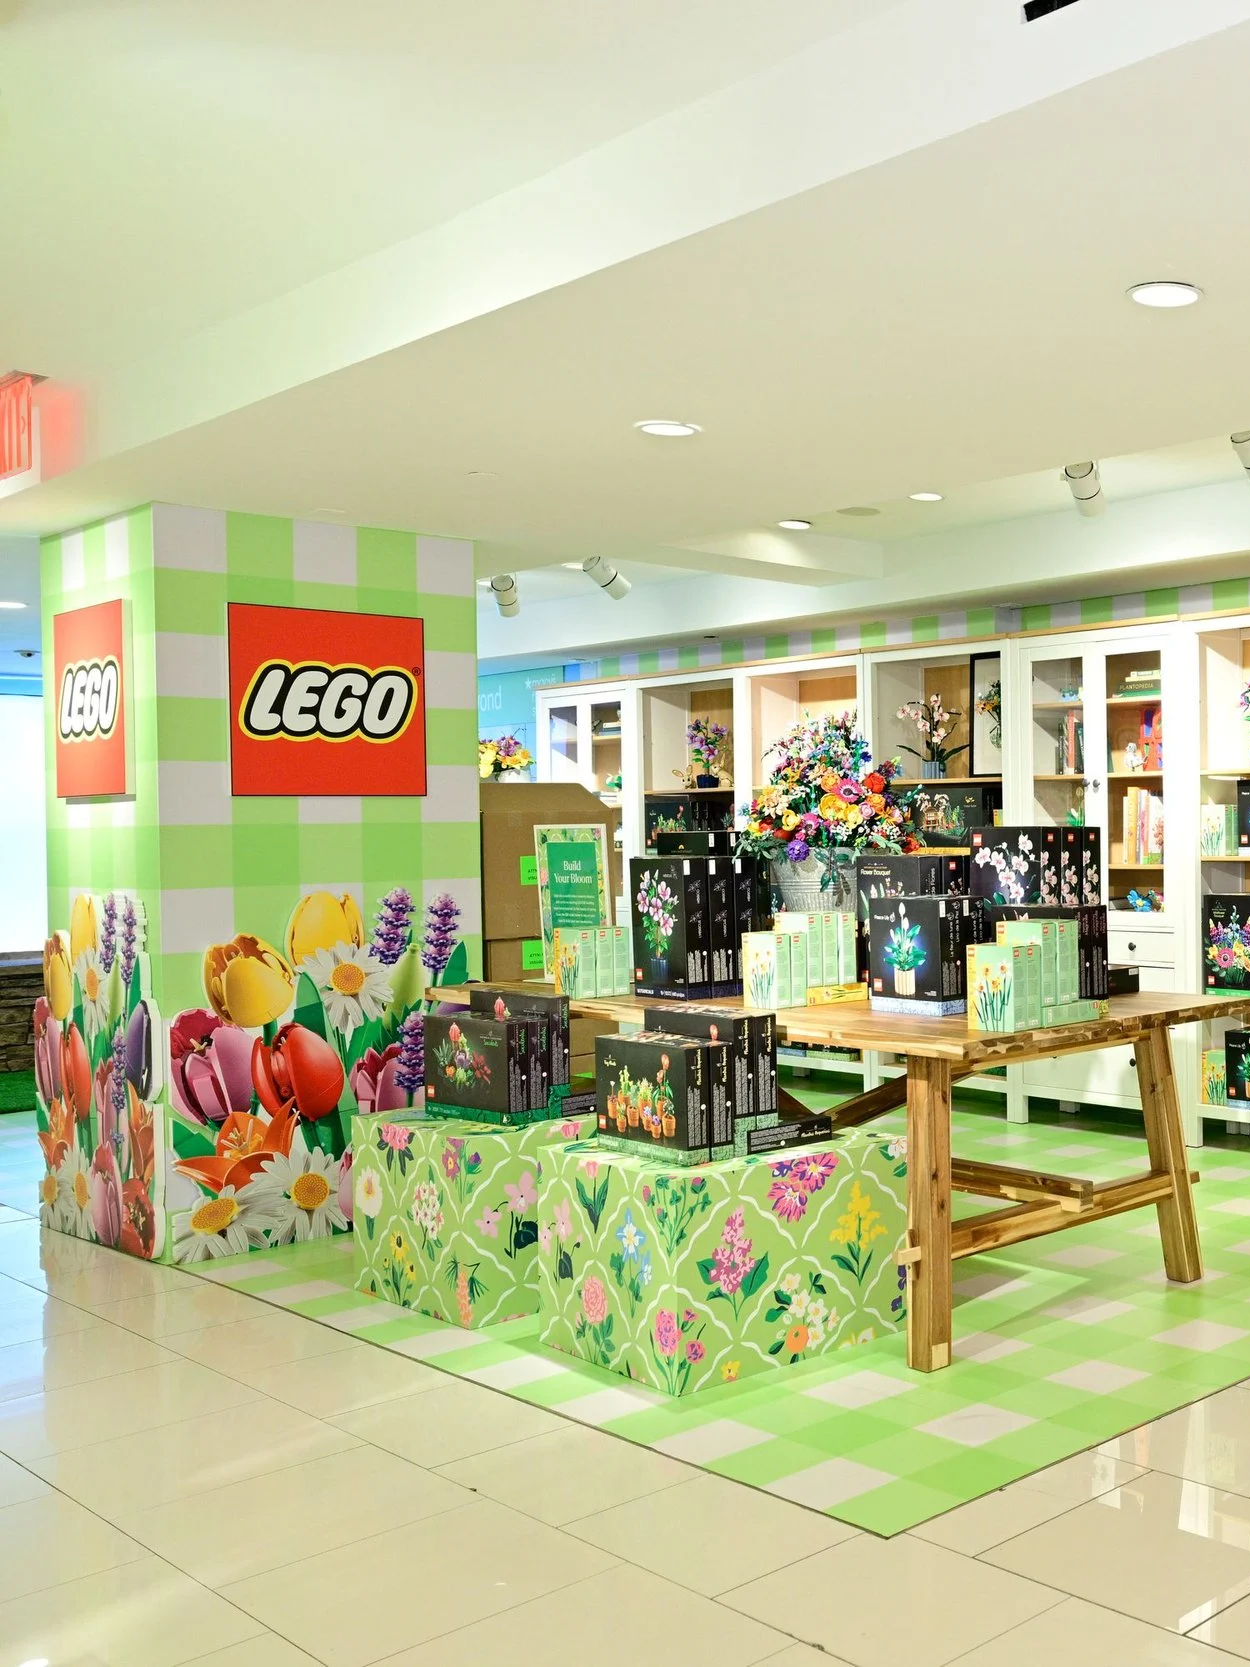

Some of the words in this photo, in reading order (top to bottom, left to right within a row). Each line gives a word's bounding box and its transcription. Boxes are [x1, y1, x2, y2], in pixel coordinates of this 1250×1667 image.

[60, 658, 119, 741] LEGO
[242, 662, 415, 740] LEGO
[478, 685, 502, 711] ond
[554, 872, 570, 884] Your
[570, 873, 593, 884] Bloom
[563, 860, 582, 871] Build
